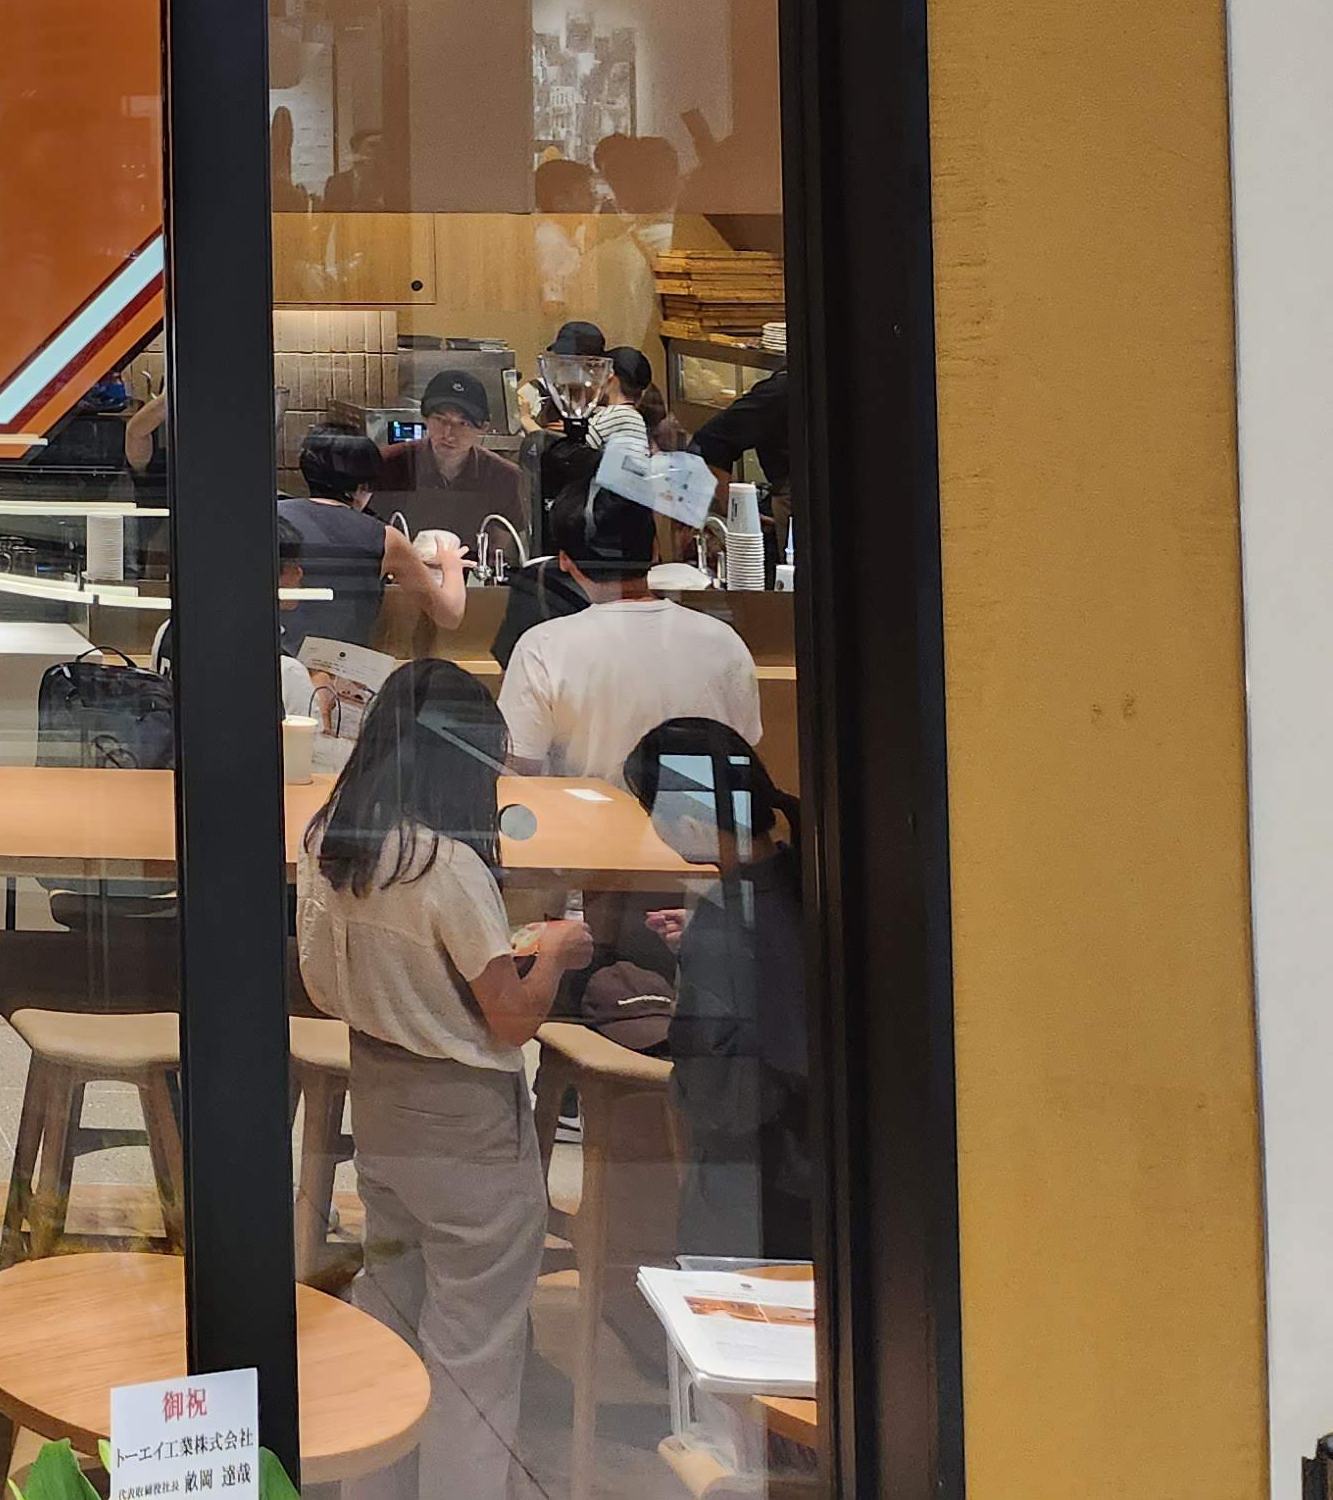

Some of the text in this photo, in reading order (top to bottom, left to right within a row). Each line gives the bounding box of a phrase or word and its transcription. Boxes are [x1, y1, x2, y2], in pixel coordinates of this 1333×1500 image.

[162, 1387, 208, 1423] 御祝
[116, 1427, 254, 1468] トーエイ工業株式会社
